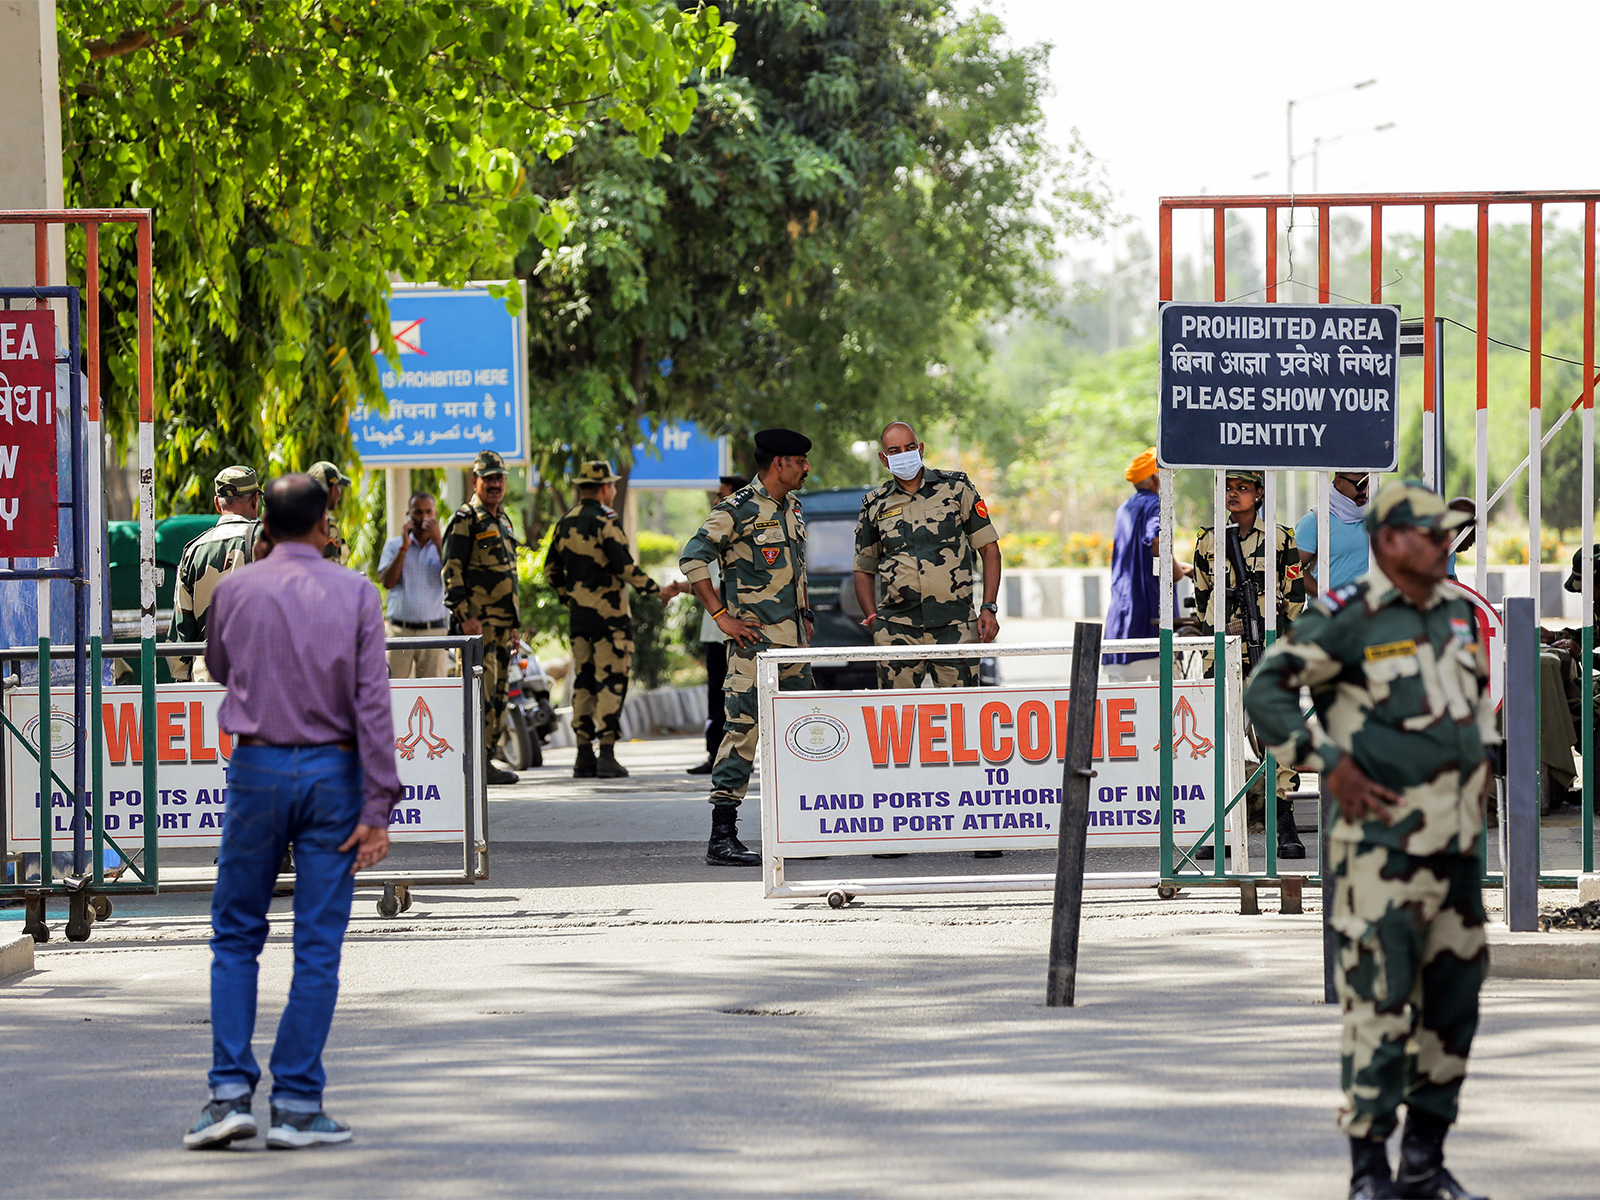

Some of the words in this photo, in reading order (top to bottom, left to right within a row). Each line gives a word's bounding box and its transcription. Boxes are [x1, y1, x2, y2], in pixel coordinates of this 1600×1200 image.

[1181, 315, 1317, 340] PROHIBITED
[1320, 317, 1385, 341] AREA
[1169, 343, 1216, 374] बिना
[1219, 351, 1271, 377] आज्ञा
[1276, 344, 1331, 377] प्रवेश
[1337, 344, 1394, 378] निषेध
[398, 369, 473, 388] PROHIBITED
[474, 368, 510, 387] HERE
[442, 402, 478, 418] मना
[1172, 385, 1256, 411] PLEASE
[1261, 387, 1326, 412] SHOW
[1329, 387, 1391, 412] YOUR
[1219, 422, 1328, 447] IDENTITY
[985, 768, 1009, 785] TO
[109, 789, 187, 807] POTS
[800, 793, 864, 811] LAND
[873, 791, 950, 809] PORTS
[958, 787, 1062, 807] AUTHORI
[1098, 786, 1128, 802] OF
[129, 812, 191, 831] PRT
[820, 816, 884, 834] LAND
[893, 814, 955, 832] PORT
[962, 811, 1051, 831] ATTARI,
